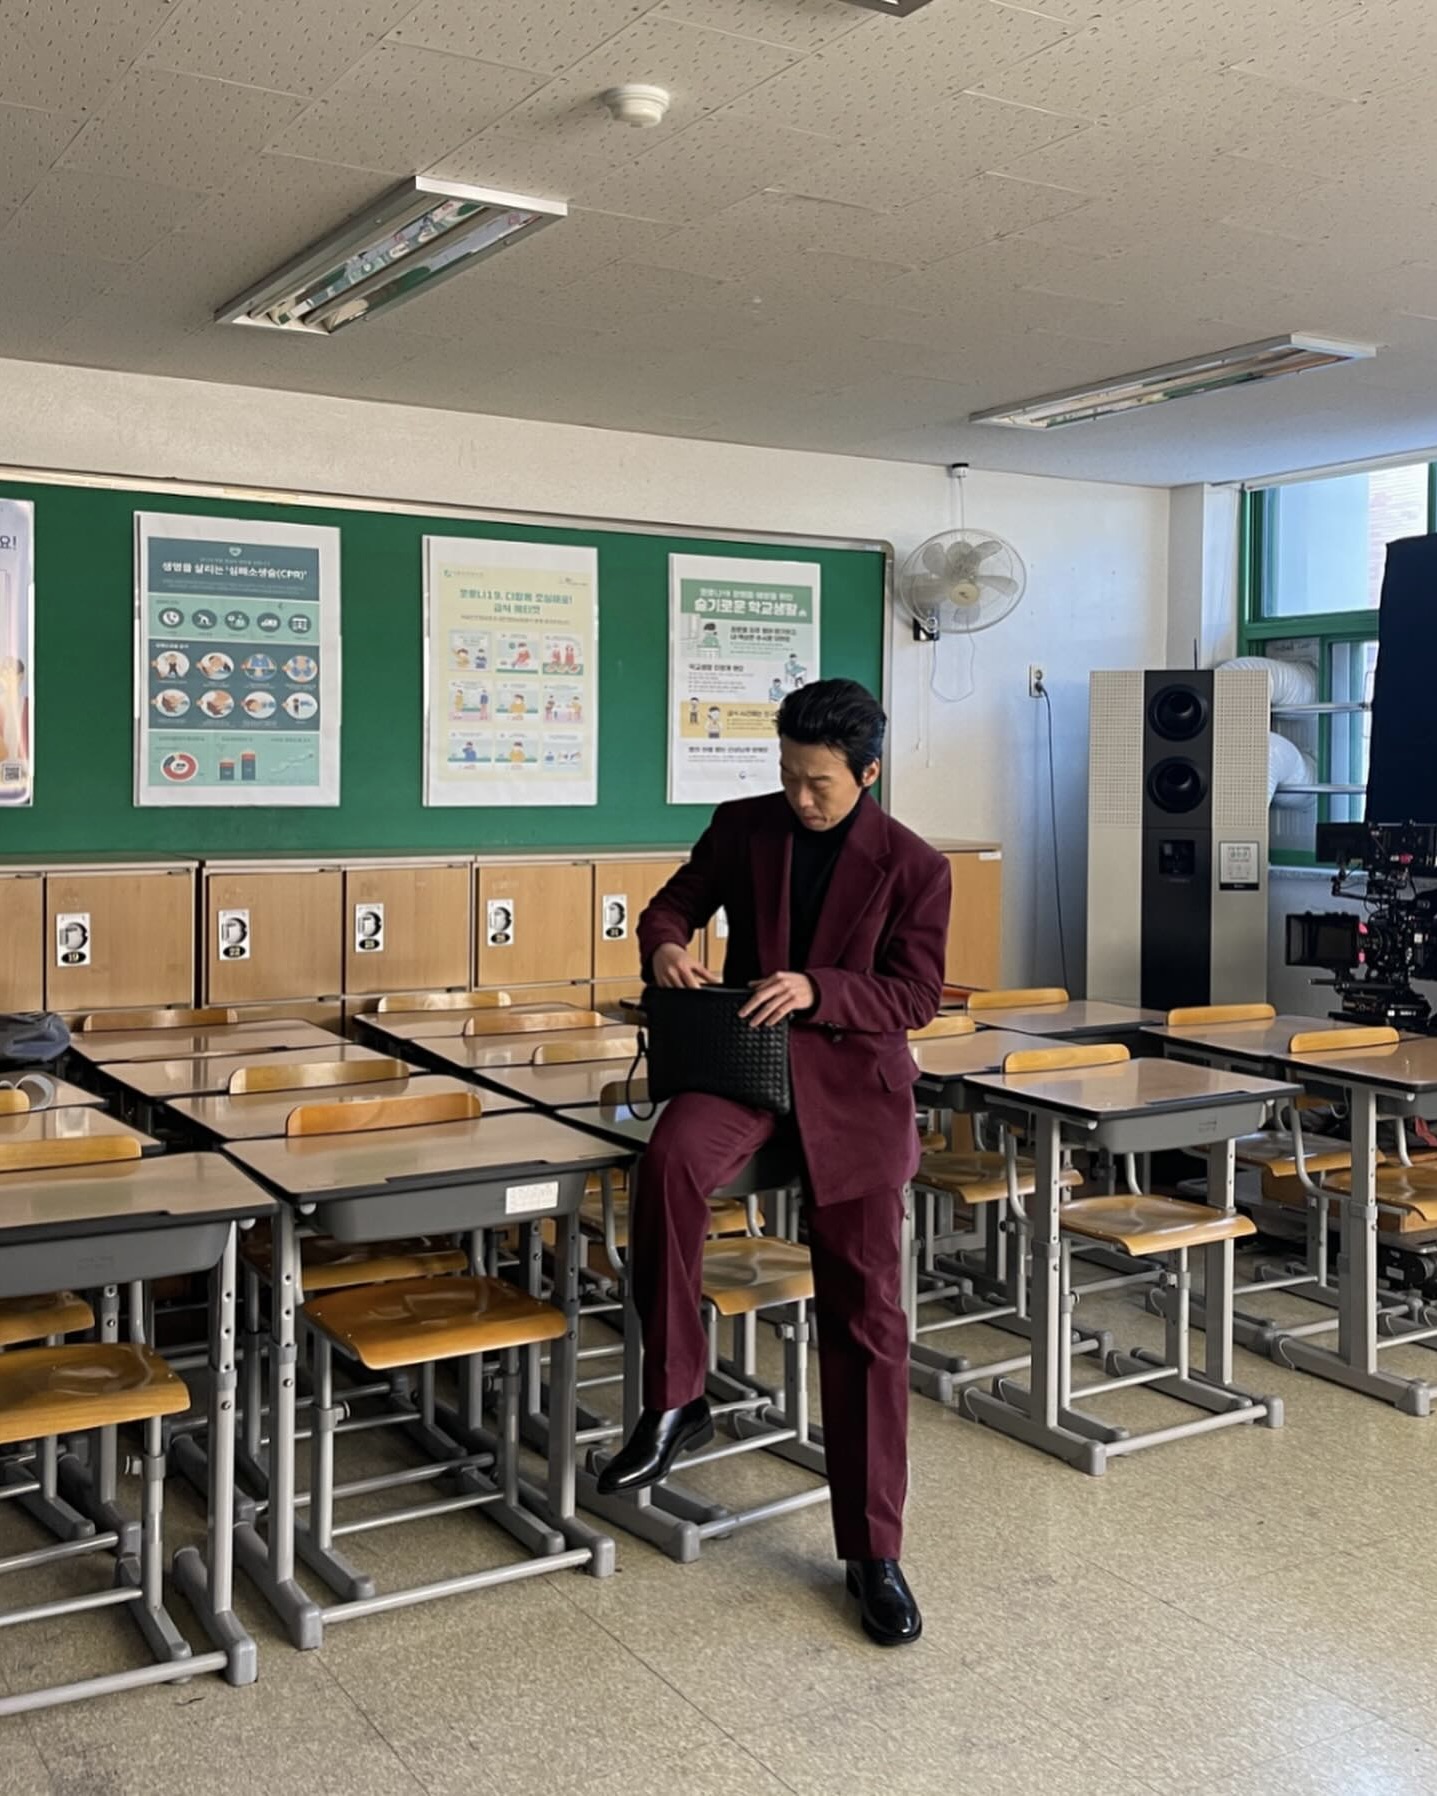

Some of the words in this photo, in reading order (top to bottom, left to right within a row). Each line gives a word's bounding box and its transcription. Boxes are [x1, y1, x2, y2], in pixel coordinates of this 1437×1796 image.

[694, 598, 746, 614] 슬기로운
[748, 600, 798, 617] 학교생활
[68, 952, 79, 963] 19
